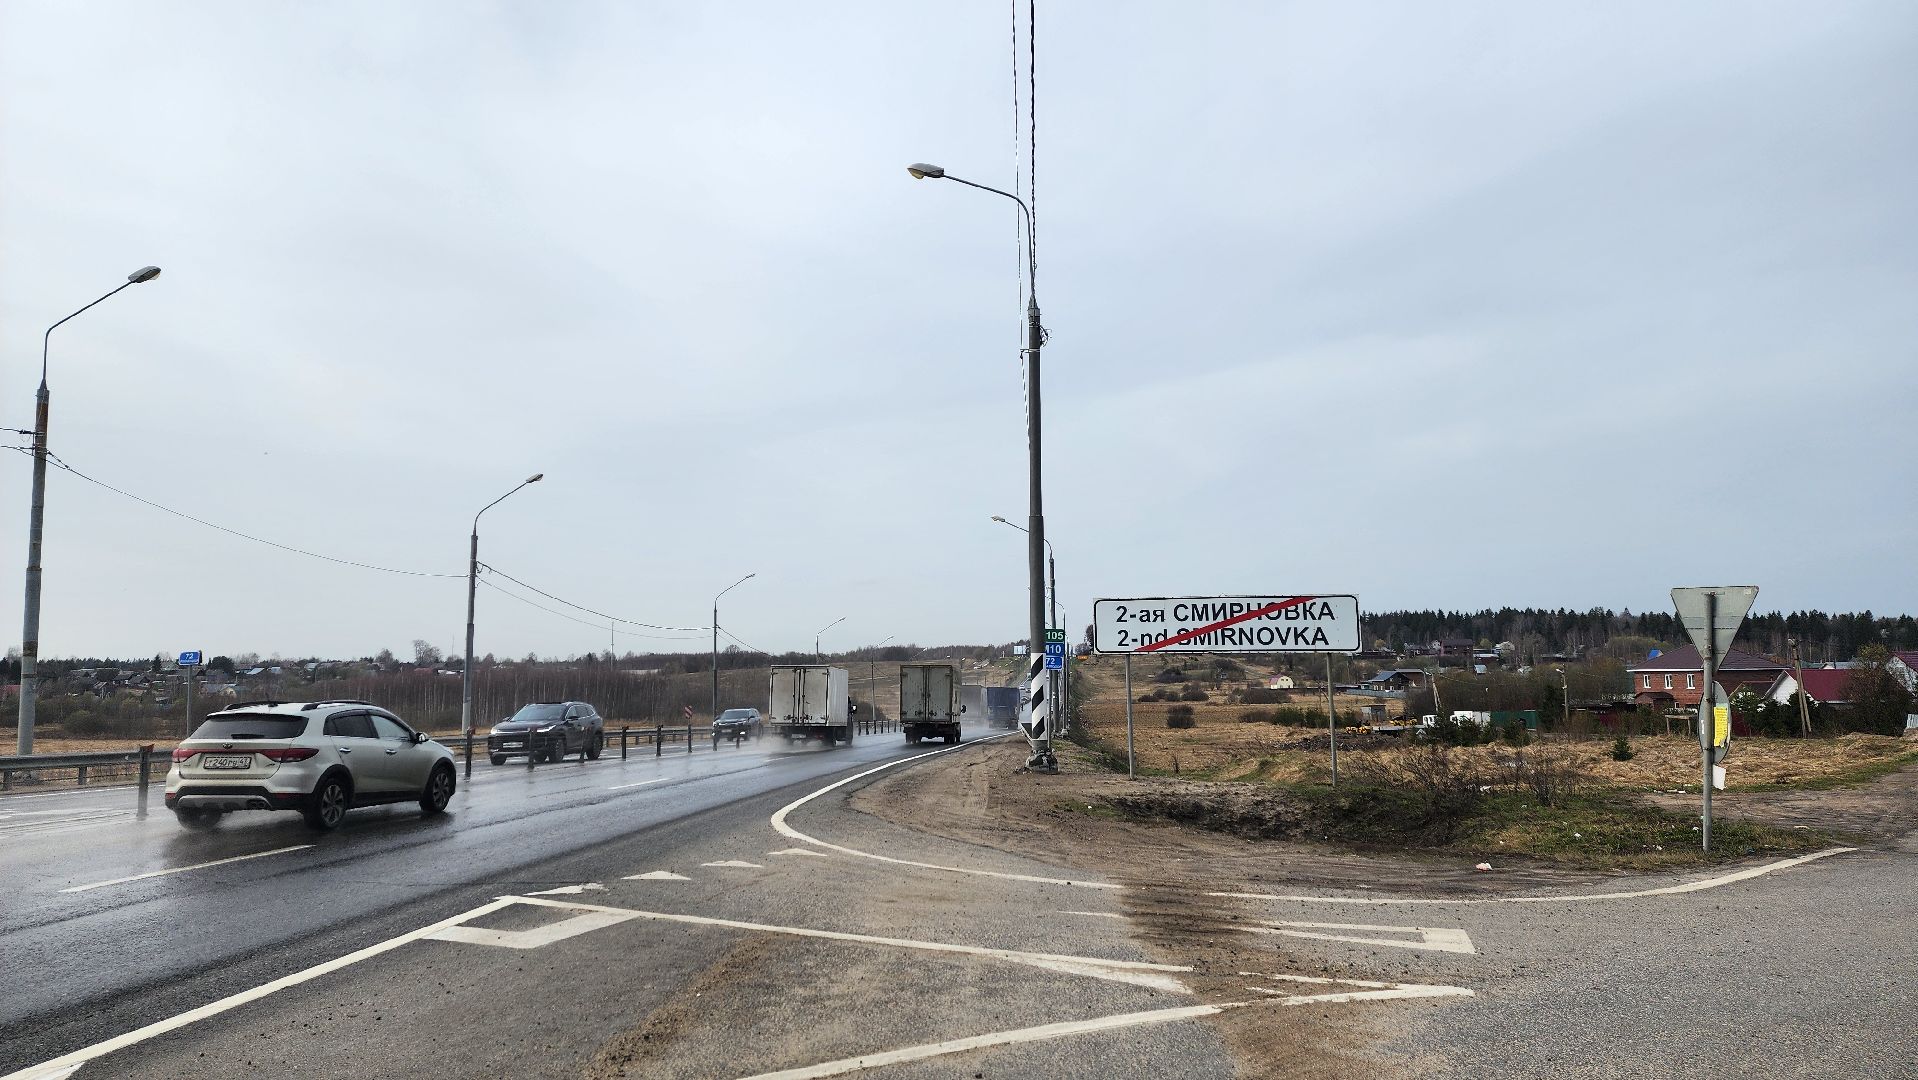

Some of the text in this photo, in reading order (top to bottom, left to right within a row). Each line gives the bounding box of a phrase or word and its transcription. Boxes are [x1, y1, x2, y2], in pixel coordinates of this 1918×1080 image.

[1115, 601, 1335, 623] 2-ая СМИРНОВКА
[1046, 631, 1064, 640] 105
[1117, 626, 1330, 647] 2-nd SMIRNOVKA
